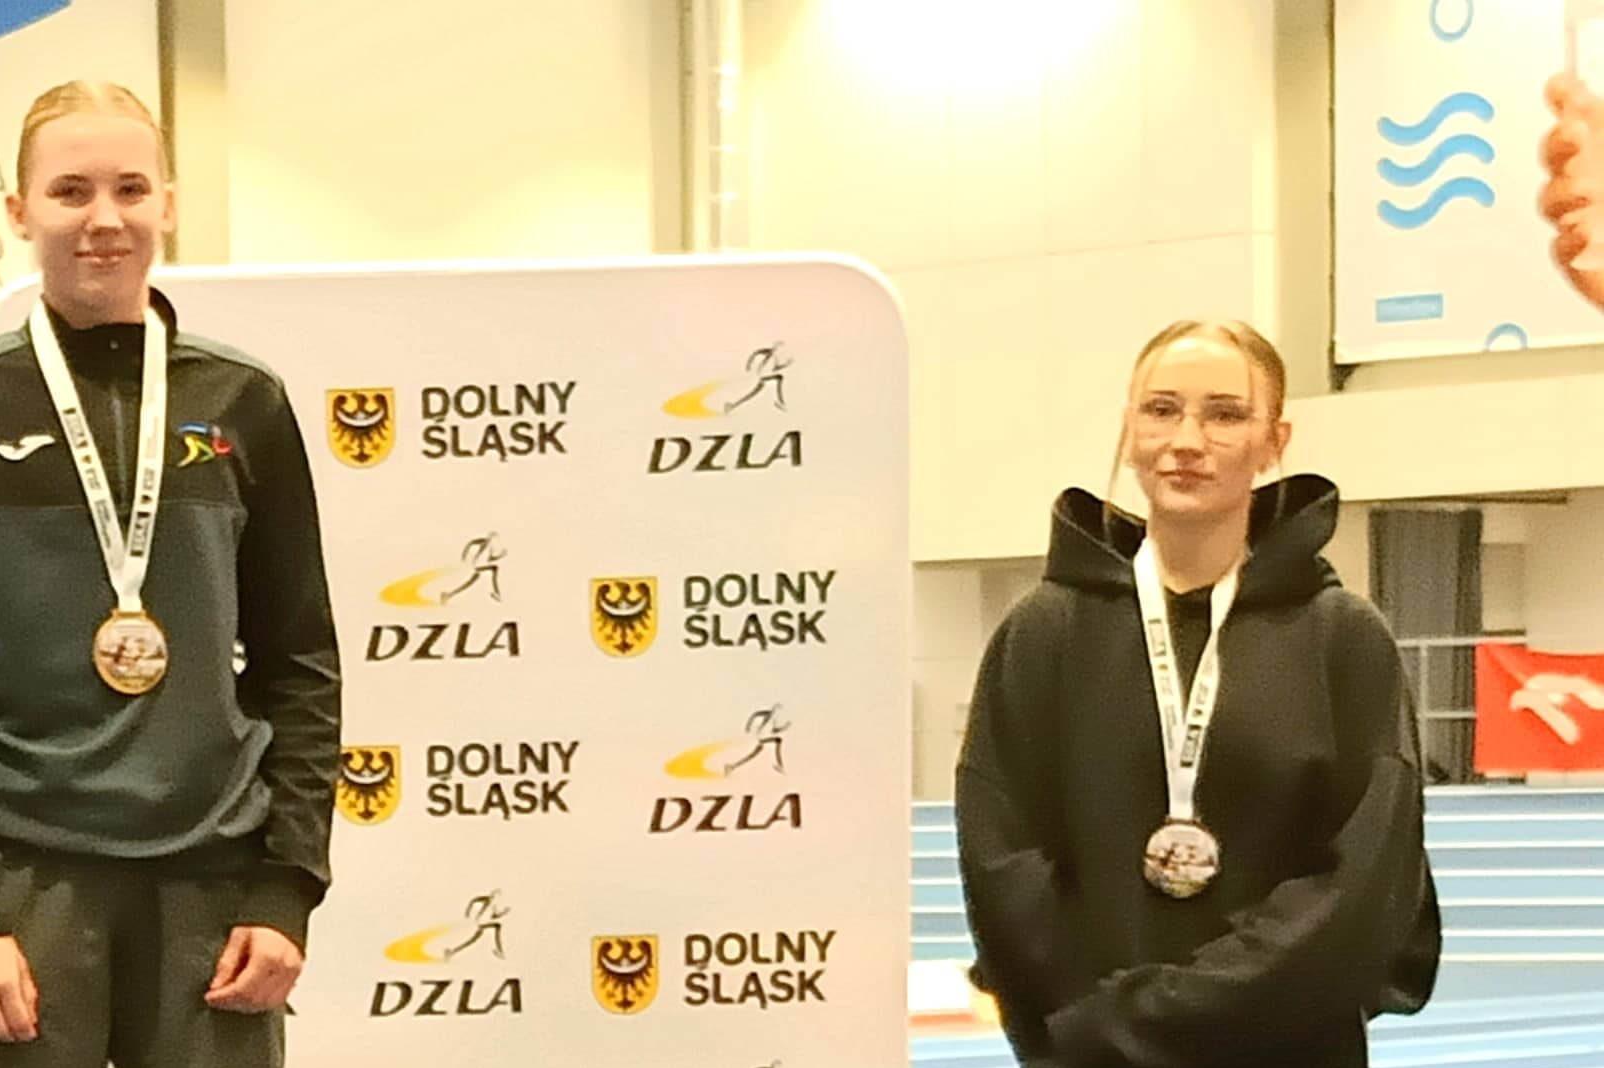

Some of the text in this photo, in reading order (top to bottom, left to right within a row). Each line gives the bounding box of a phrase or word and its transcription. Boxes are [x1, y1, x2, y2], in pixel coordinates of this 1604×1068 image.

[422, 382, 576, 418] DOLNY
[423, 416, 565, 461] ŚLĄSK
[649, 431, 801, 473] DZLA
[684, 571, 835, 607] DOLNY
[366, 622, 519, 661] DZLA
[684, 606, 825, 650] ŚLĄSK
[427, 741, 579, 777] DOLNY
[428, 775, 567, 820] ŚLĄSK
[650, 793, 801, 832] DZLA
[685, 931, 836, 966] DOLNY
[371, 978, 521, 1016] DZLA
[685, 964, 824, 1009] ŚLĄSK
